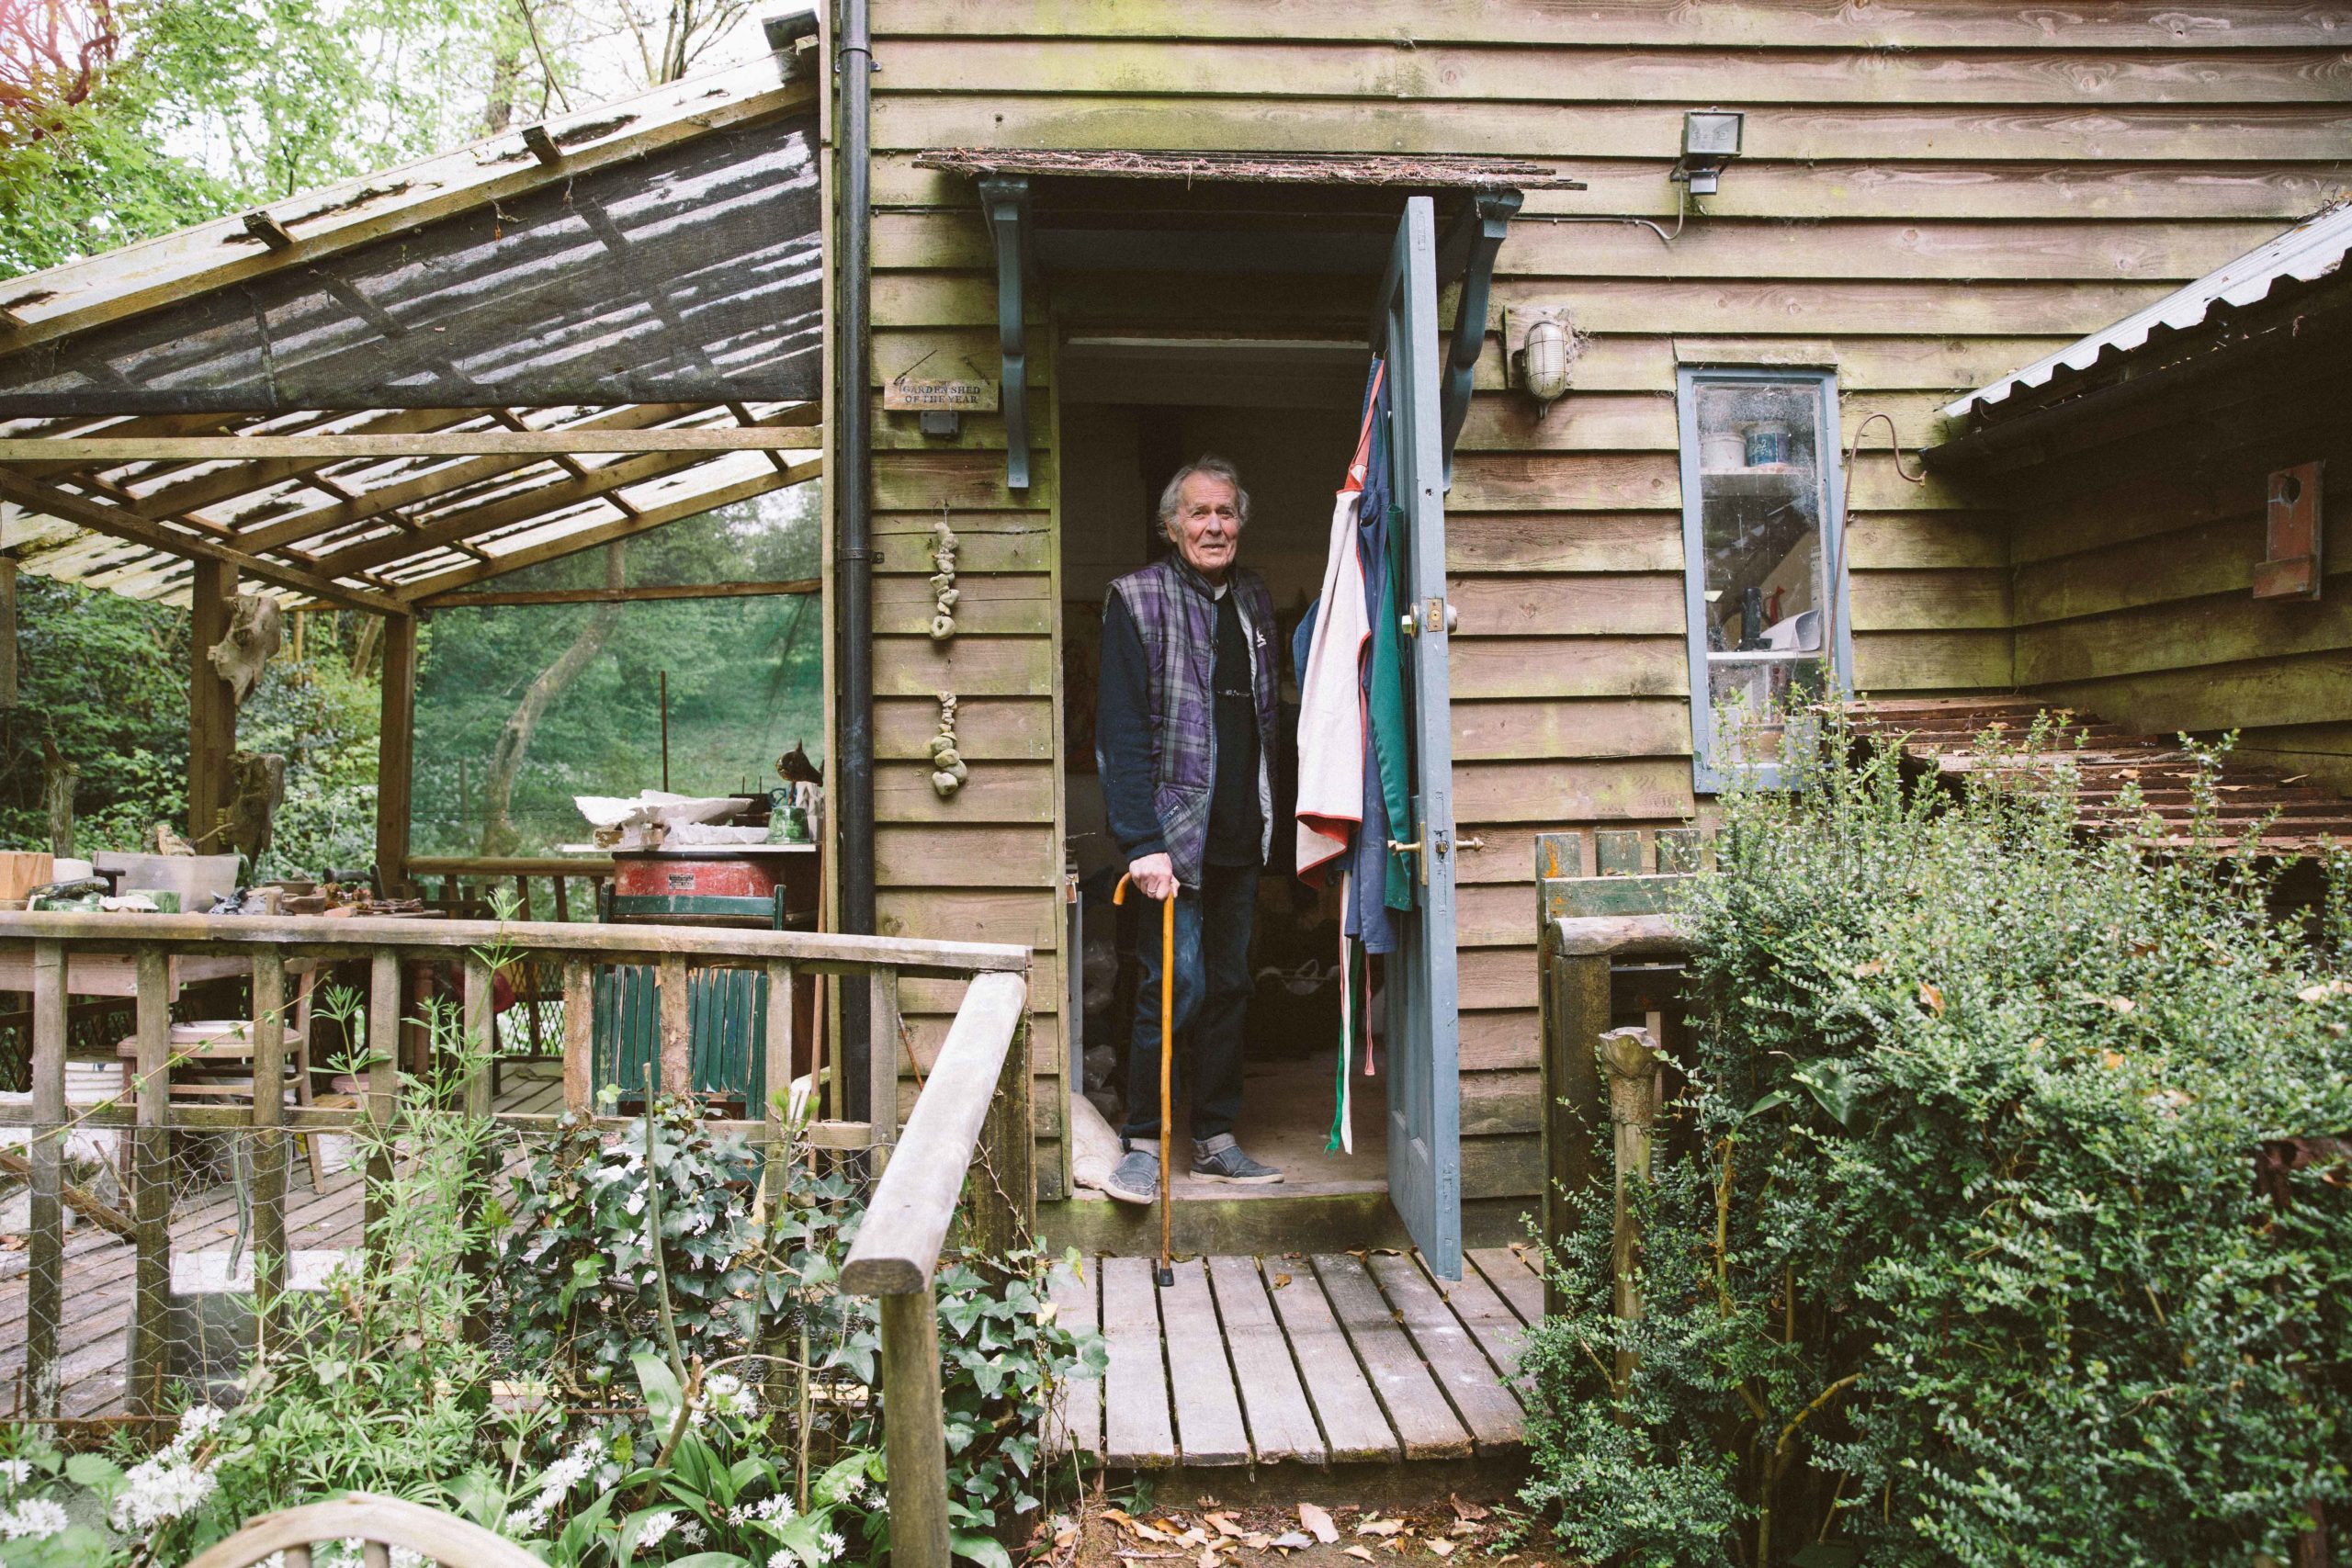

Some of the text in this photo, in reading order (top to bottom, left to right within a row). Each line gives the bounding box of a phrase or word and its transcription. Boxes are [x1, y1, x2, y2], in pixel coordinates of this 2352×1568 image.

[903, 386, 980, 394] GARDEN SHED
[905, 395, 978, 403] OF THE YEAR
